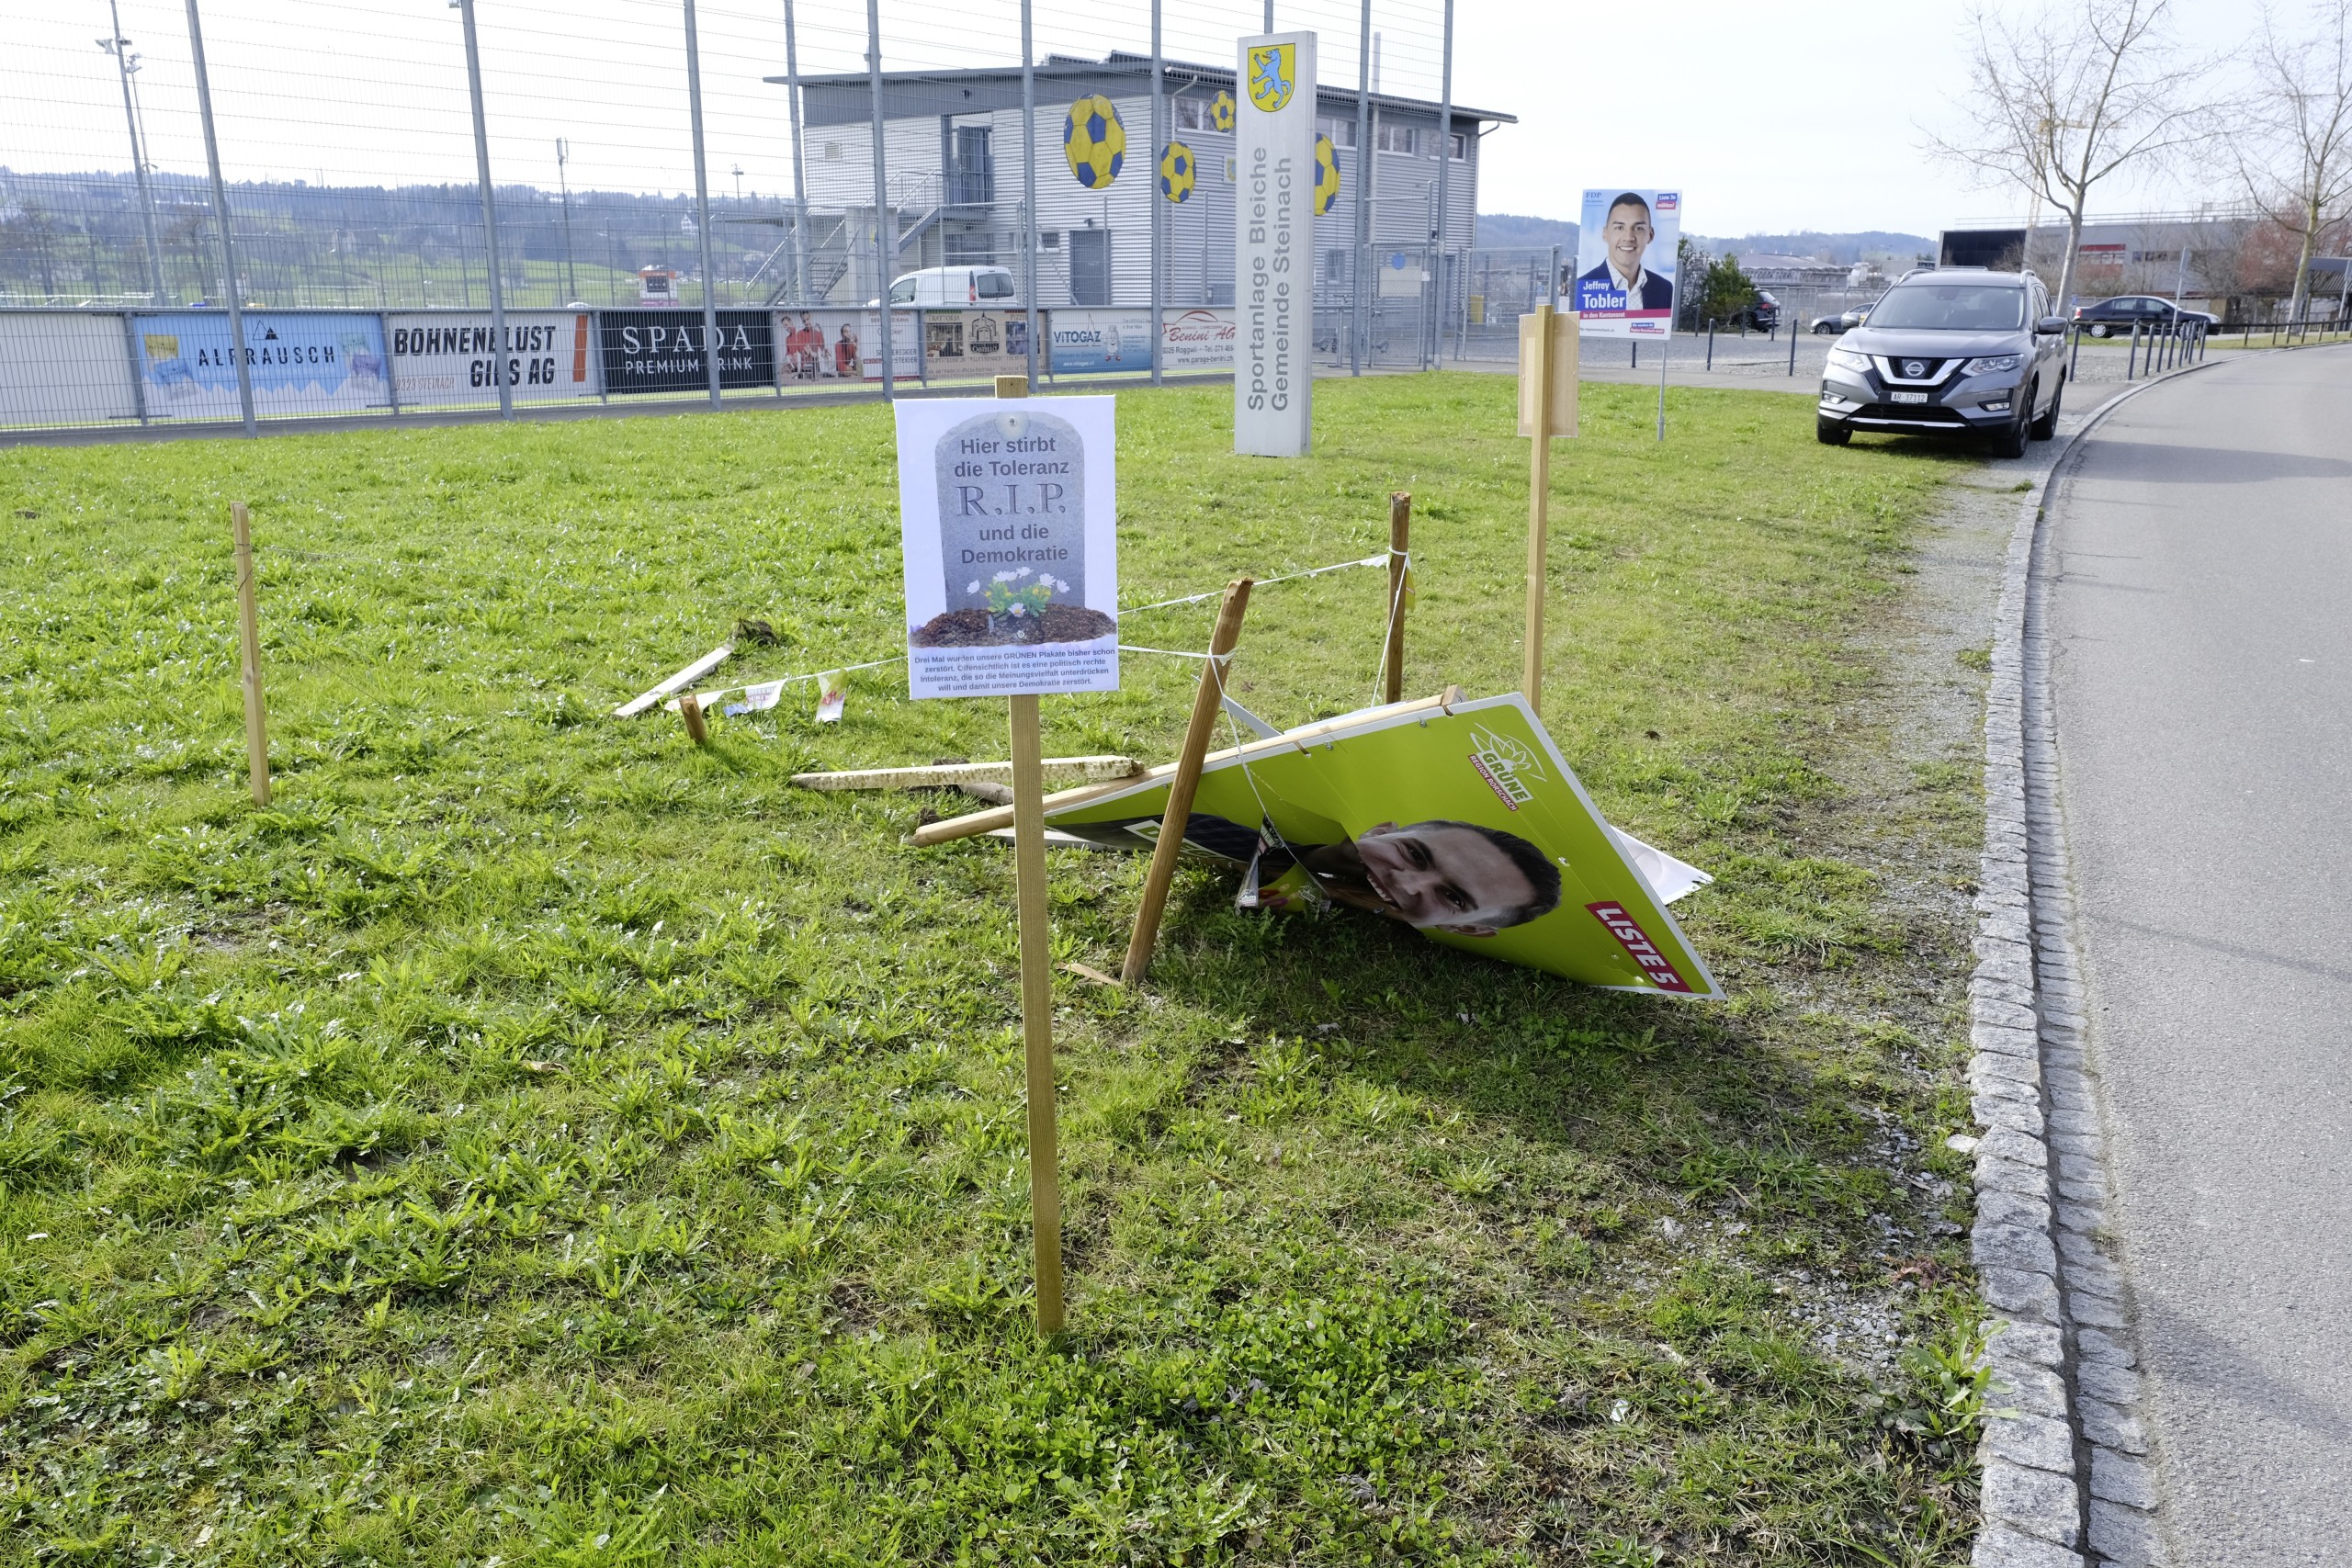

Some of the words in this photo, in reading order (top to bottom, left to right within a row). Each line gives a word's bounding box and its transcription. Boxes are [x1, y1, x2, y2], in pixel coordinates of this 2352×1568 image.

[1250, 146, 1267, 244] Bleiche
[1273, 156, 1292, 274] Steinach
[1583, 281, 1610, 291] Jeffrey
[1582, 293, 1625, 309] Tobler
[1169, 327, 1210, 342] Benini
[1214, 326, 1236, 341] AG
[1248, 255, 1270, 412] Sportanlage
[1272, 282, 1290, 411] Gemeinde
[527, 357, 555, 385] AG
[626, 358, 699, 375] PREMIUM
[708, 356, 752, 371] RINK
[961, 438, 1000, 455] Hier
[1006, 436, 1056, 453] stirbt
[954, 462, 983, 478] die
[989, 460, 1069, 477] Toleranz
[956, 482, 1067, 516] R.I.P.
[979, 525, 1014, 542] und
[1021, 525, 1049, 540] die
[961, 546, 1069, 564] Demokratie
[1003, 651, 1037, 660] GRÜNEN
[1039, 650, 1066, 659] Plakate
[1049, 660, 1081, 669] politisch
[920, 674, 959, 683] Intoleranz,
[998, 670, 1058, 680] Meinungsvielfalt
[1060, 668, 1109, 676] unterdrücken
[1019, 679, 1061, 688] Demokratie
[1062, 678, 1092, 686] zerstört.
[1469, 755, 1490, 778] REGION
[1487, 777, 1518, 811] RORSCHACH
[1482, 752, 1530, 801] GRÜNE
[1596, 908, 1667, 969] LISTE
[1652, 971, 1679, 985] 5
